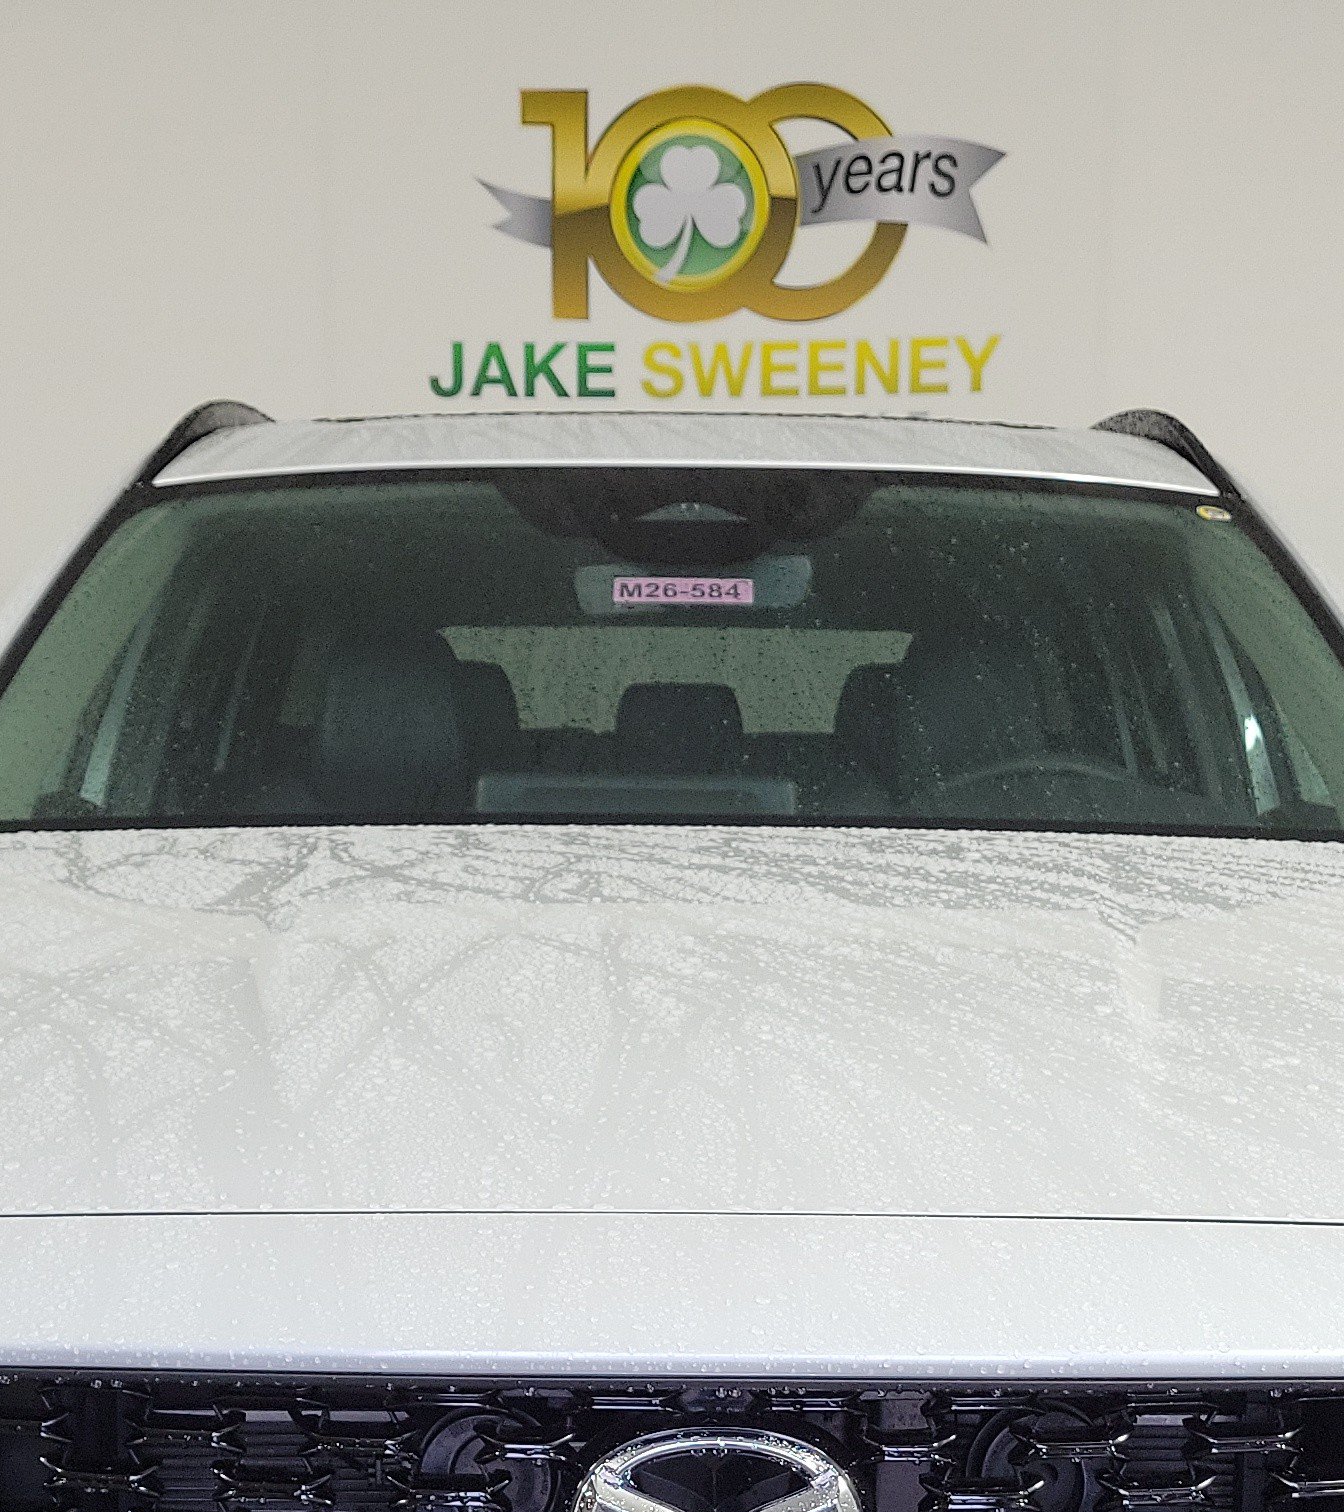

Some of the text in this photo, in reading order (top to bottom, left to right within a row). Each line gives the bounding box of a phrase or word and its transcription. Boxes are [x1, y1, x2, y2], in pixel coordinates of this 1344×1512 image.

[520, 82, 907, 322] 100
[811, 147, 959, 215] years
[428, 334, 1002, 399] JAKE SWEENEY
[619, 583, 741, 599] M26-584
